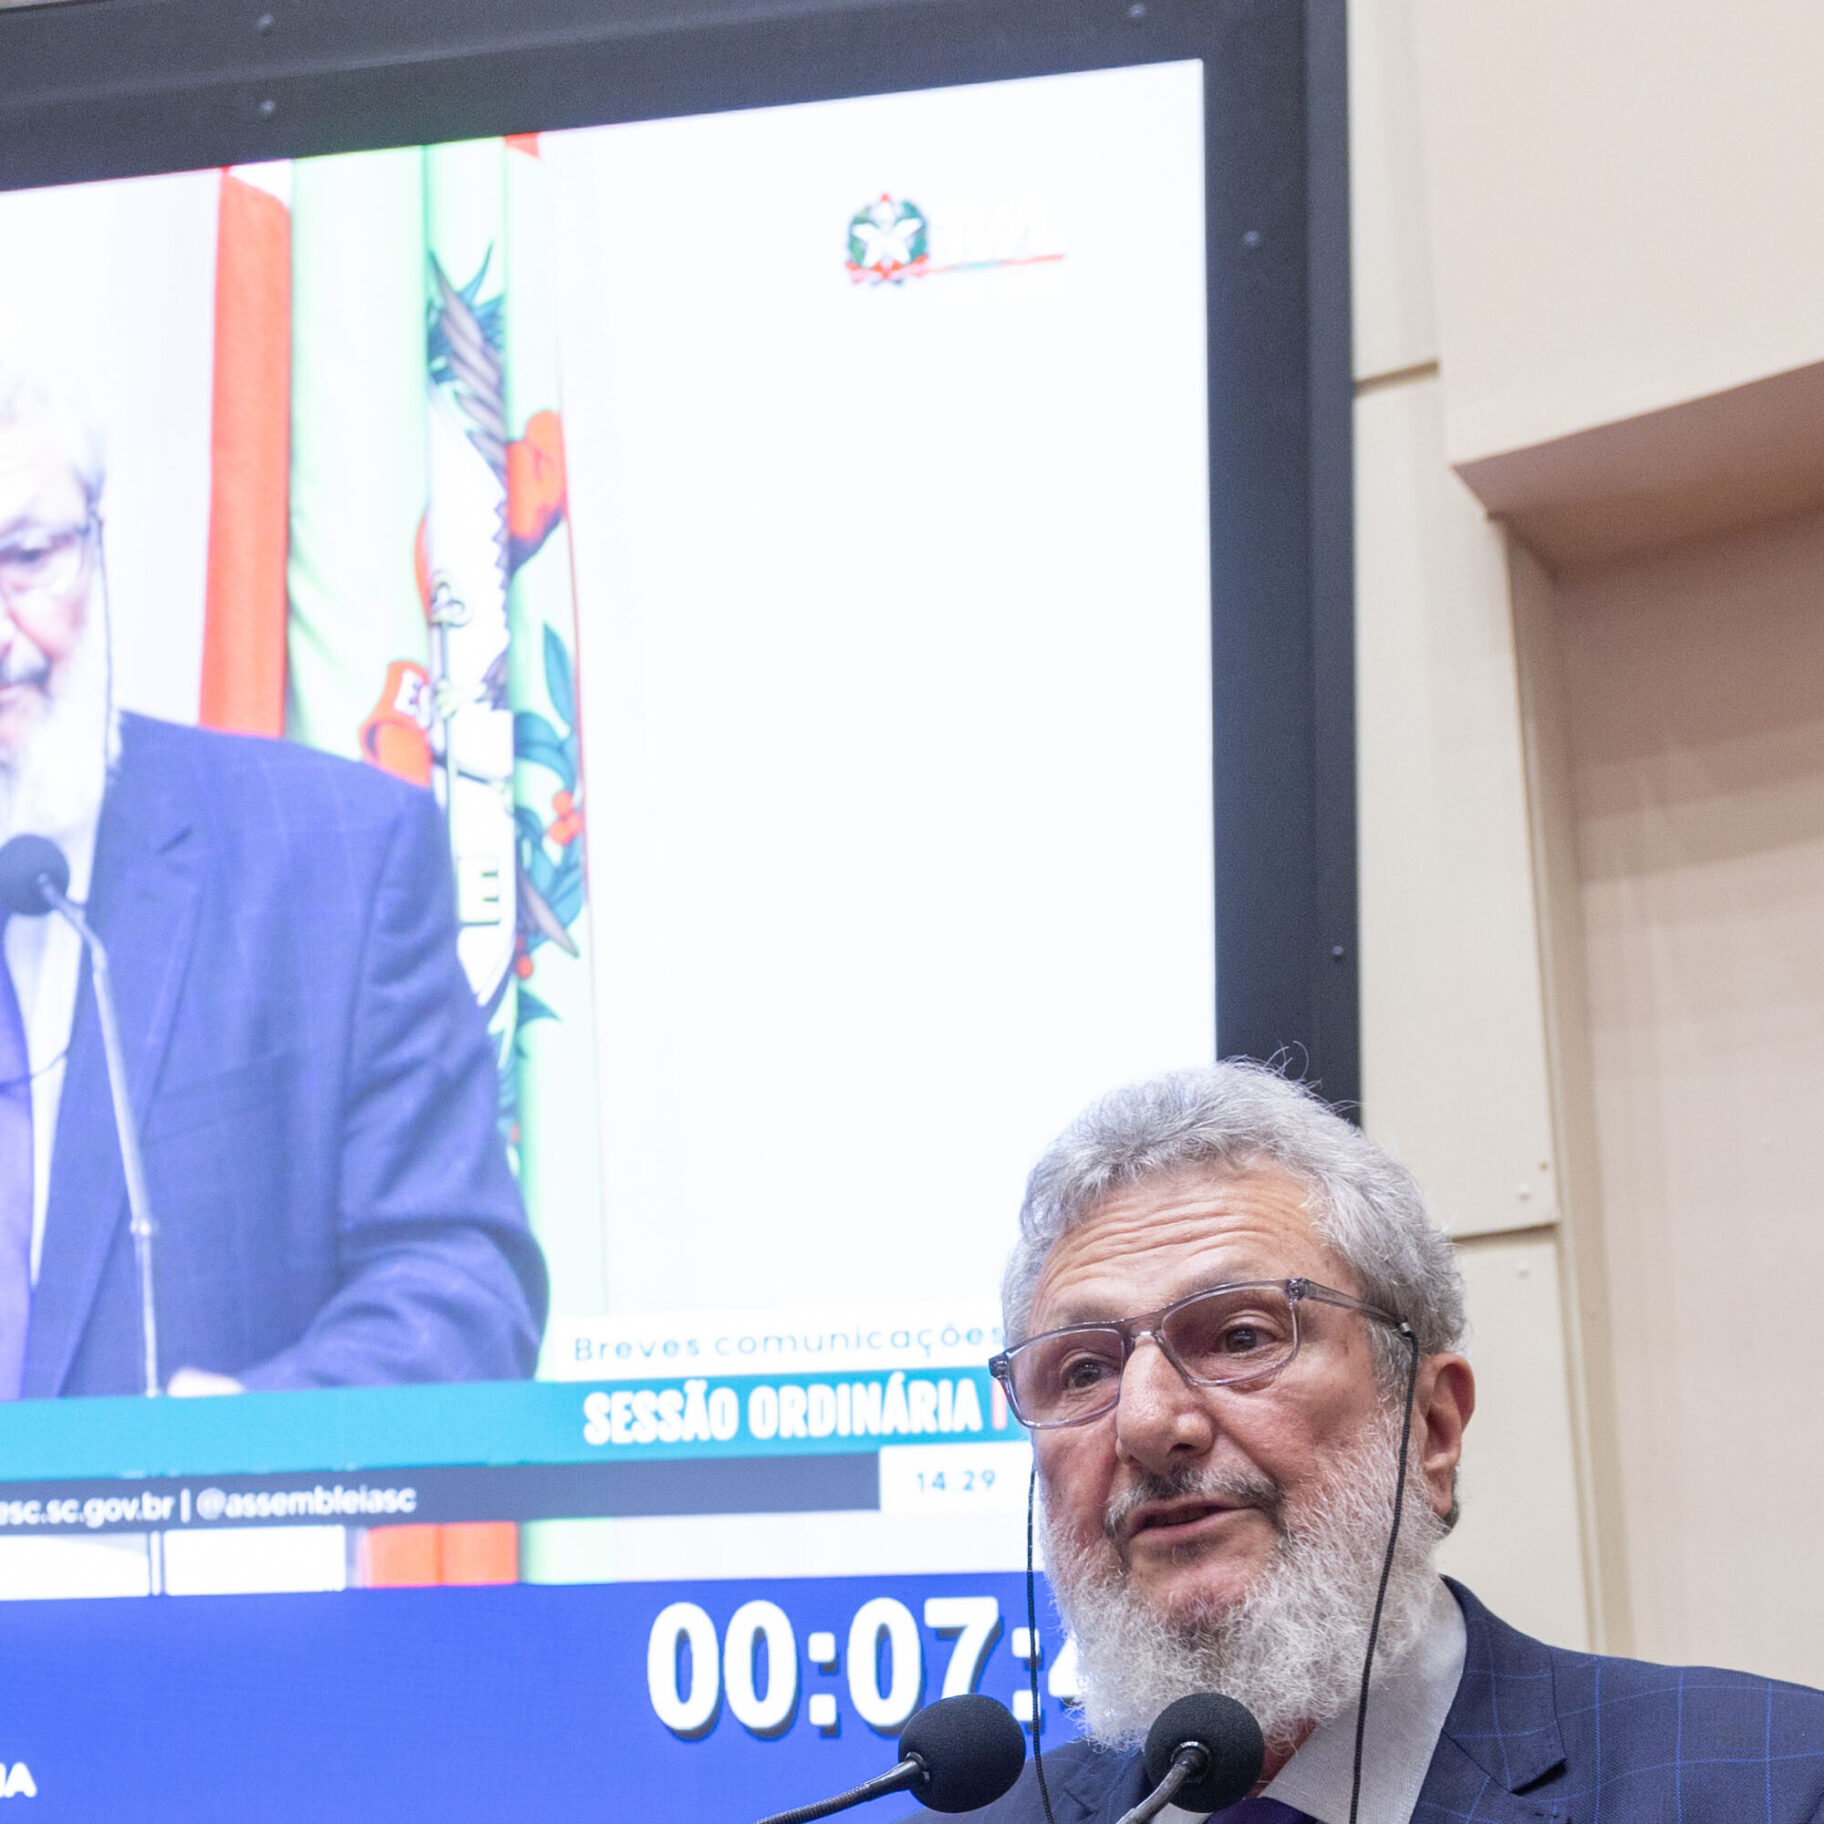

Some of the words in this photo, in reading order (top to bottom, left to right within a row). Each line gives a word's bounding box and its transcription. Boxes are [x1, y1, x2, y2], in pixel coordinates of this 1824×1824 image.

[574, 1337, 701, 1363] Breves
[583, 1379, 739, 1446] SESSÃO
[748, 1371, 983, 1440] ORDINÁRIA
[196, 1483, 417, 1520] @assembleiasc
